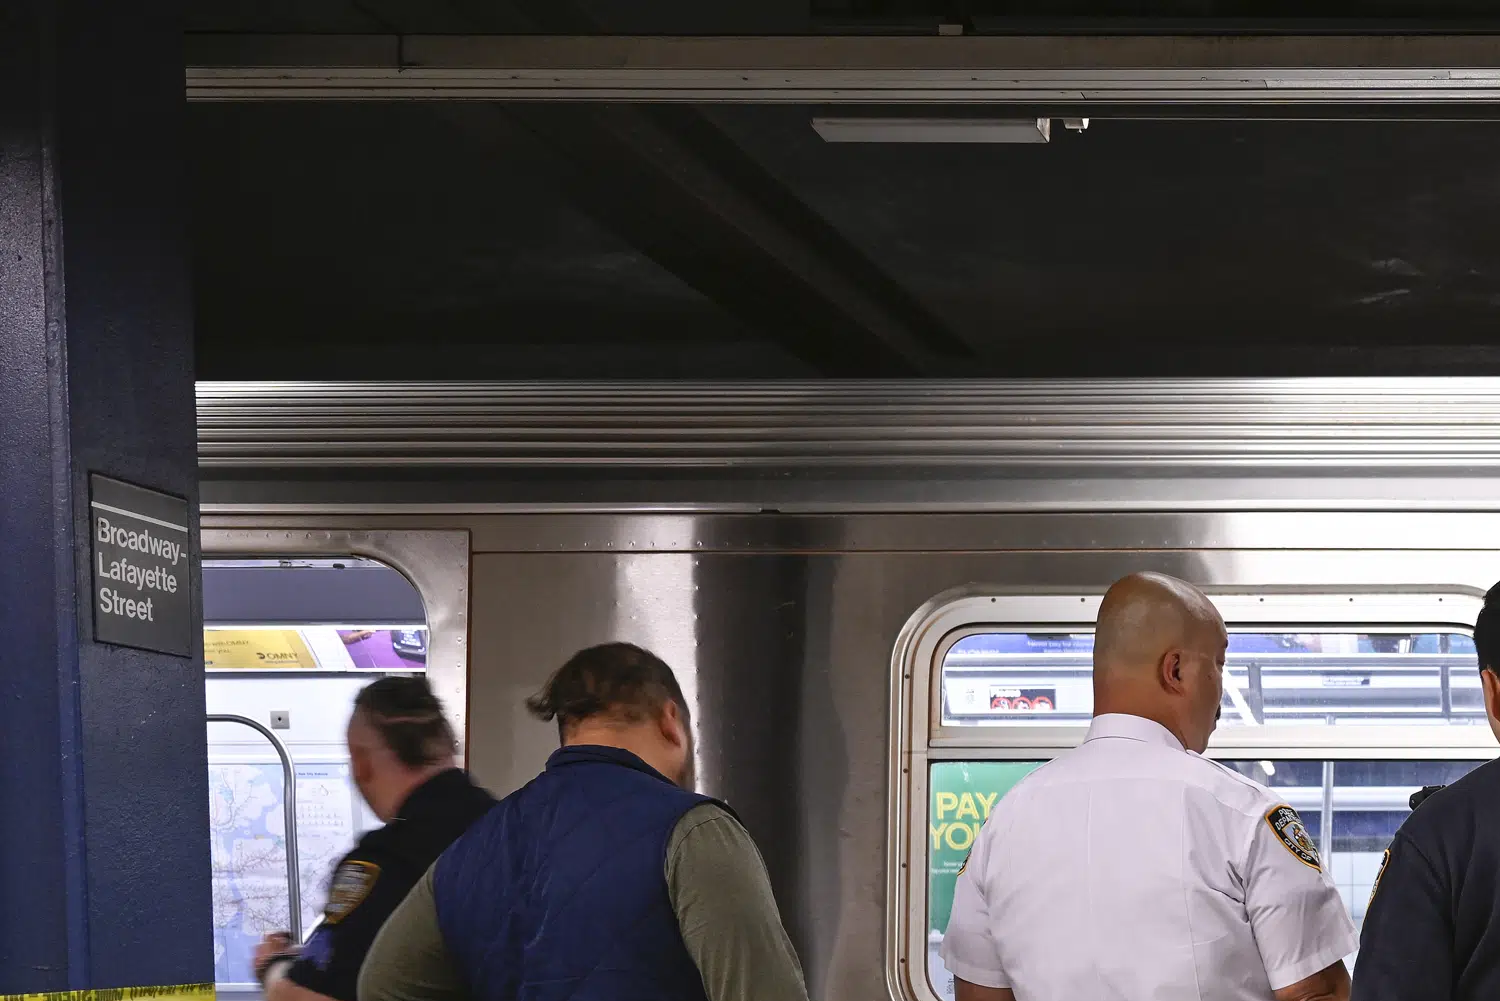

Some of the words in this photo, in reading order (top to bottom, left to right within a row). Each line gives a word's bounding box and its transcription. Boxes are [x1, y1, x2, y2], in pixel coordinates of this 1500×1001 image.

[97, 516, 187, 565] Broadway-
[98, 552, 177, 594] Lafayette
[99, 587, 154, 622] Street
[266, 652, 299, 660] OMNY
[936, 792, 998, 820] PAY
[1284, 838, 1300, 853] CITY
[1301, 852, 1313, 861] OF
